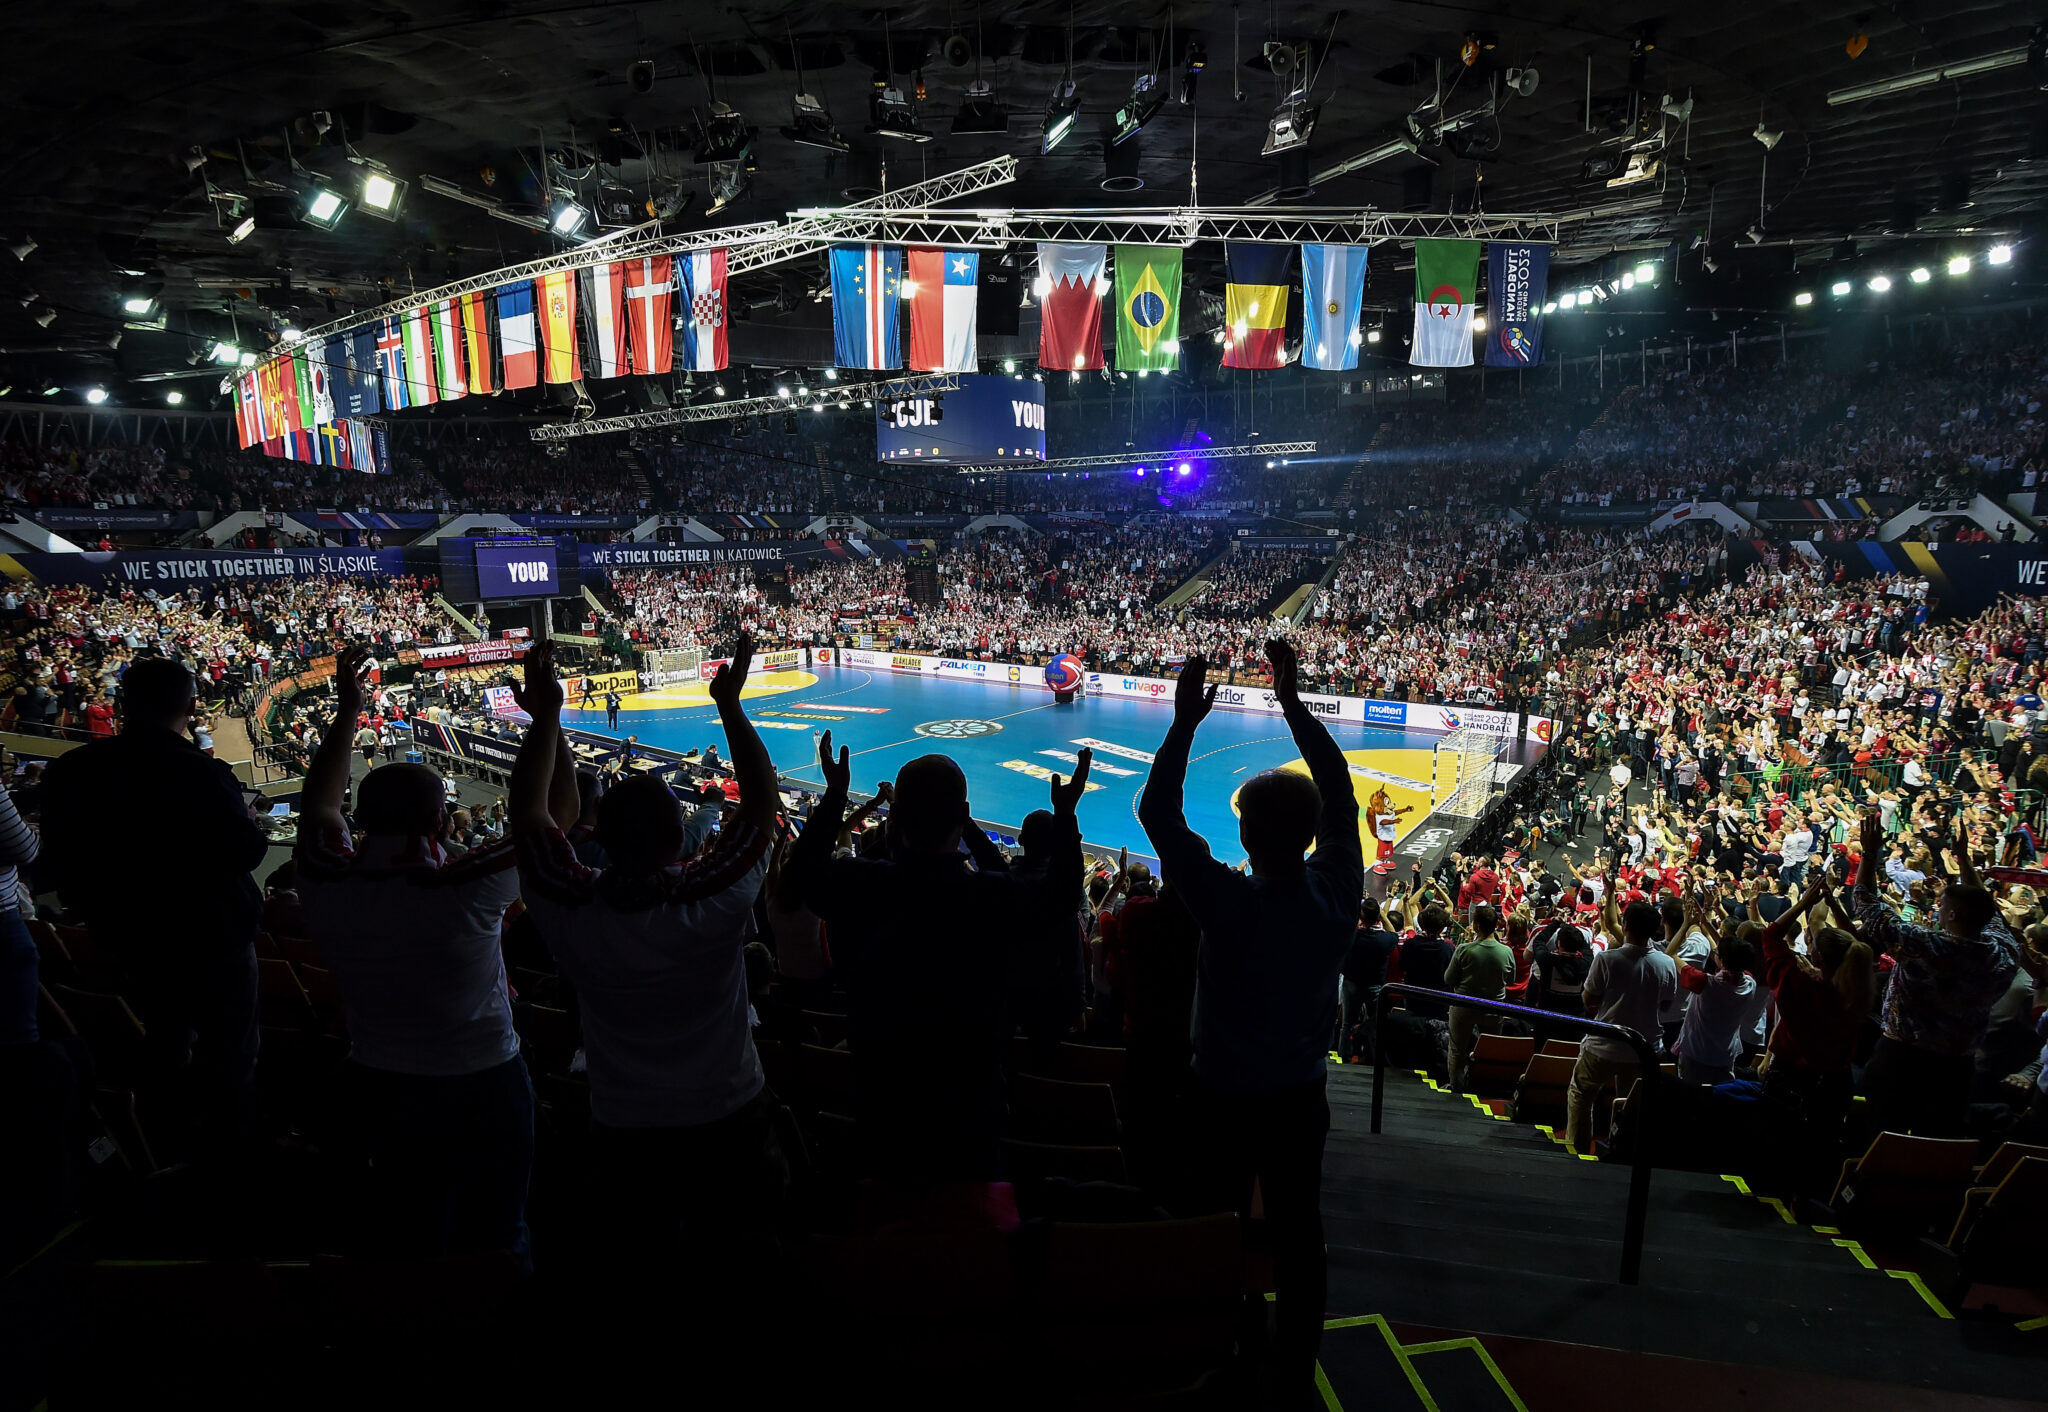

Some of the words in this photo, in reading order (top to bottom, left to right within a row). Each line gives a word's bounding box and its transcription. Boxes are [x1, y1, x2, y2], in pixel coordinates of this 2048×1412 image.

[592, 551, 612, 564] WE
[615, 550, 650, 563] STICK
[652, 550, 710, 563] TOGETHER
[713, 549, 724, 561] IN
[727, 547, 786, 561] KATOWICE.
[123, 561, 153, 580] WE
[158, 560, 209, 579] STICK
[212, 557, 295, 577] TOGETHER
[299, 557, 315, 574] IN
[318, 554, 383, 576] ŚLĄSKIE.
[507, 561, 549, 583] YOUR
[2018, 559, 2048, 585] WE
[468, 650, 513, 663] GÓRNICZA
[764, 652, 798, 665] BLÅKLÄDER
[892, 655, 922, 667] BLÅKLÄDER
[940, 660, 986, 672] FALKEN
[589, 674, 636, 692] orDan
[1122, 678, 1166, 696] trivago
[494, 688, 514, 698] LIQ
[495, 697, 515, 707] MO
[1303, 701, 1341, 714] mmel
[1368, 705, 1403, 715] molten
[1485, 715, 1513, 725] 2023
[1463, 722, 1511, 733] HANDBALL
[1401, 828, 1454, 856] Gerflor
